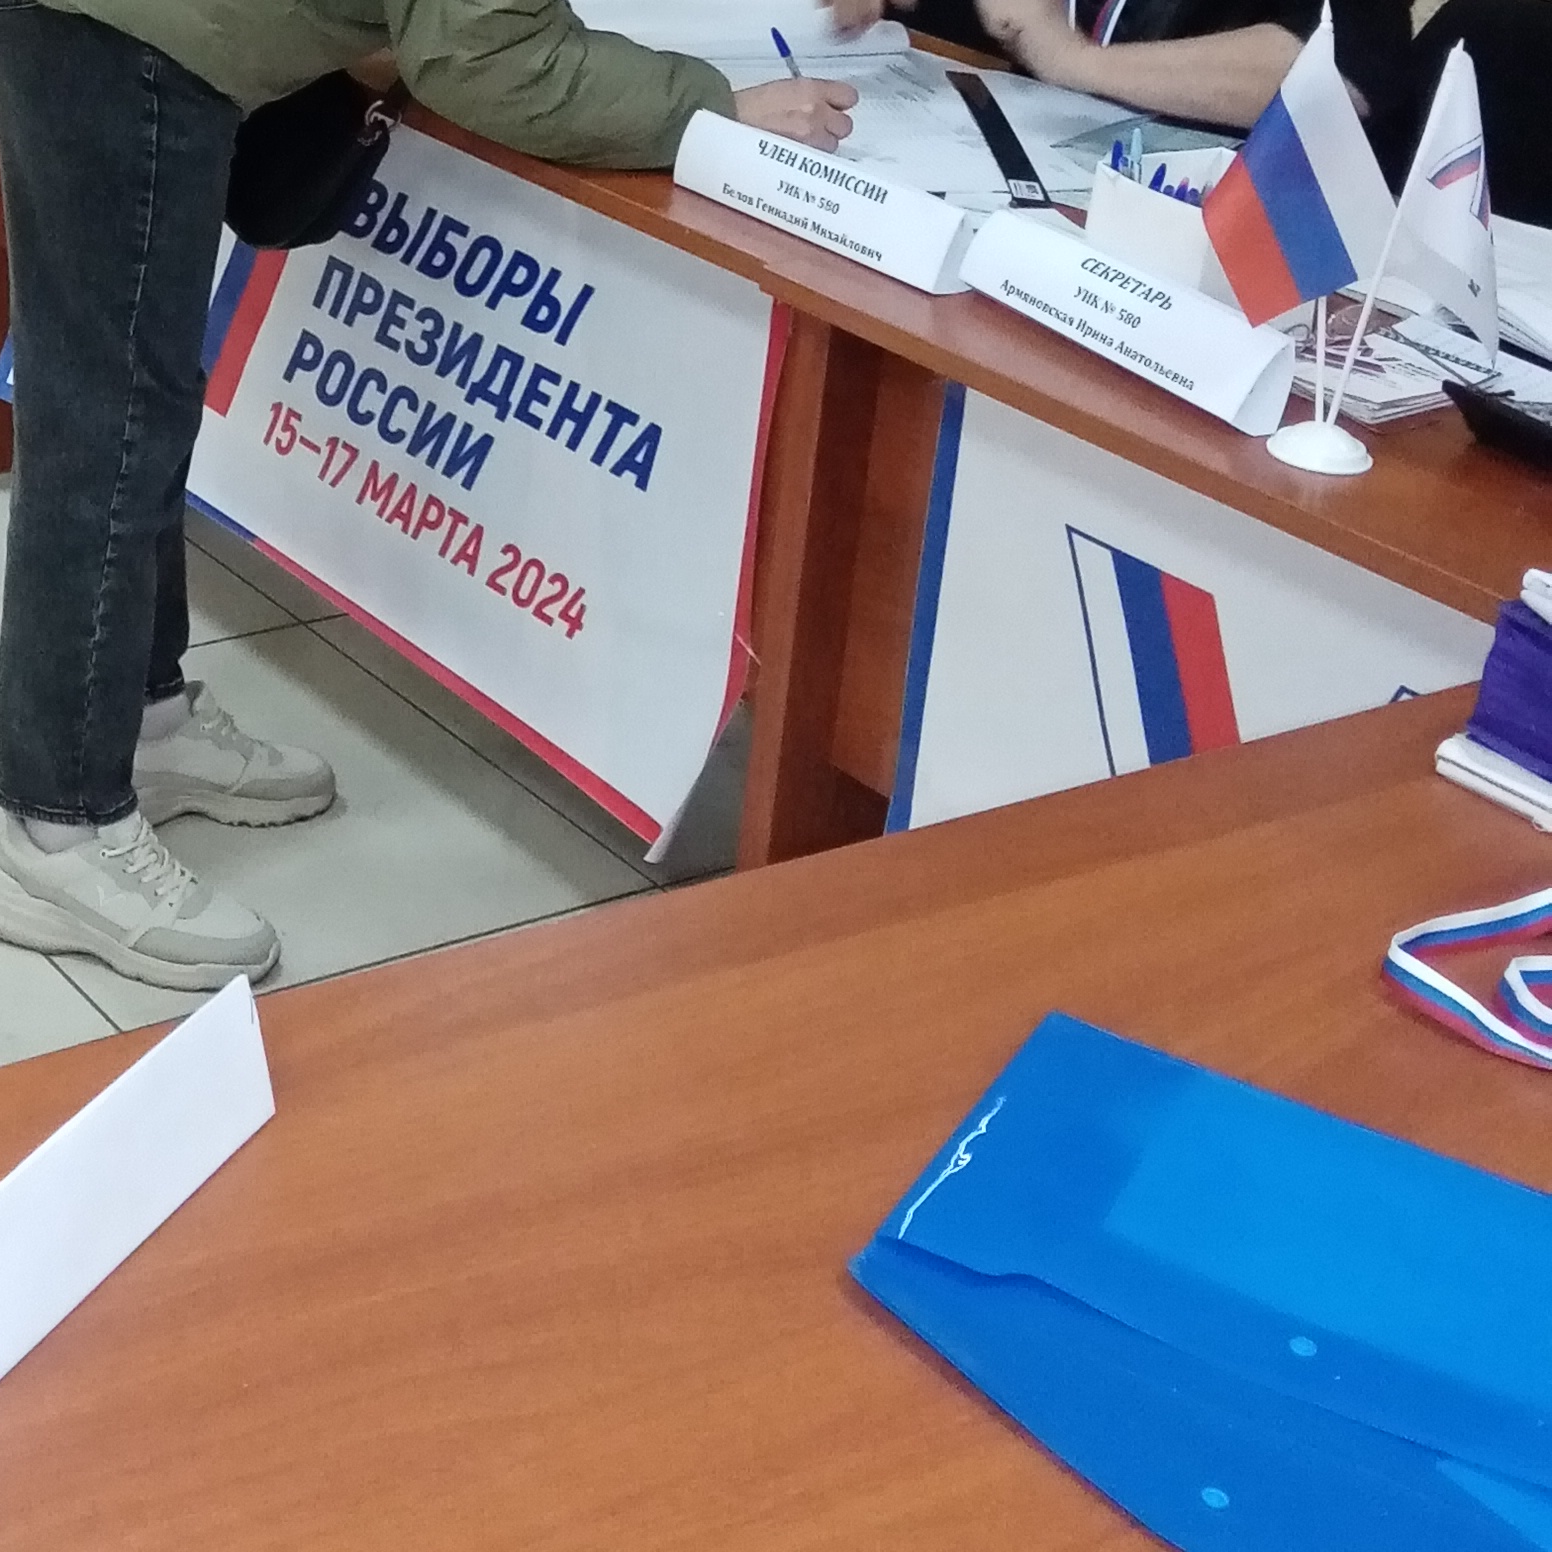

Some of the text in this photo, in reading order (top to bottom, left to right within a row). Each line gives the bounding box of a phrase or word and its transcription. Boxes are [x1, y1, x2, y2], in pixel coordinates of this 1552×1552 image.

[758, 139, 889, 204] ЧЛЕН КОМИССИИ
[776, 180, 802, 199] УИК
[817, 197, 840, 215] 580
[344, 178, 595, 346] ВЫБОРЫ
[722, 182, 883, 262] Белов Геннадий Михайлович
[1074, 286, 1099, 309] УИК
[1117, 307, 1142, 329] 580
[1080, 257, 1173, 311] СЕКРЕТАРЬ
[312, 254, 663, 493] ПРЕЗИДЕНТА
[1000, 279, 1195, 391] Армяновская Ирина Анатольевна
[283, 328, 495, 491] РОССИИ
[355, 459, 484, 577] МАРТА
[485, 543, 586, 640] 2024
